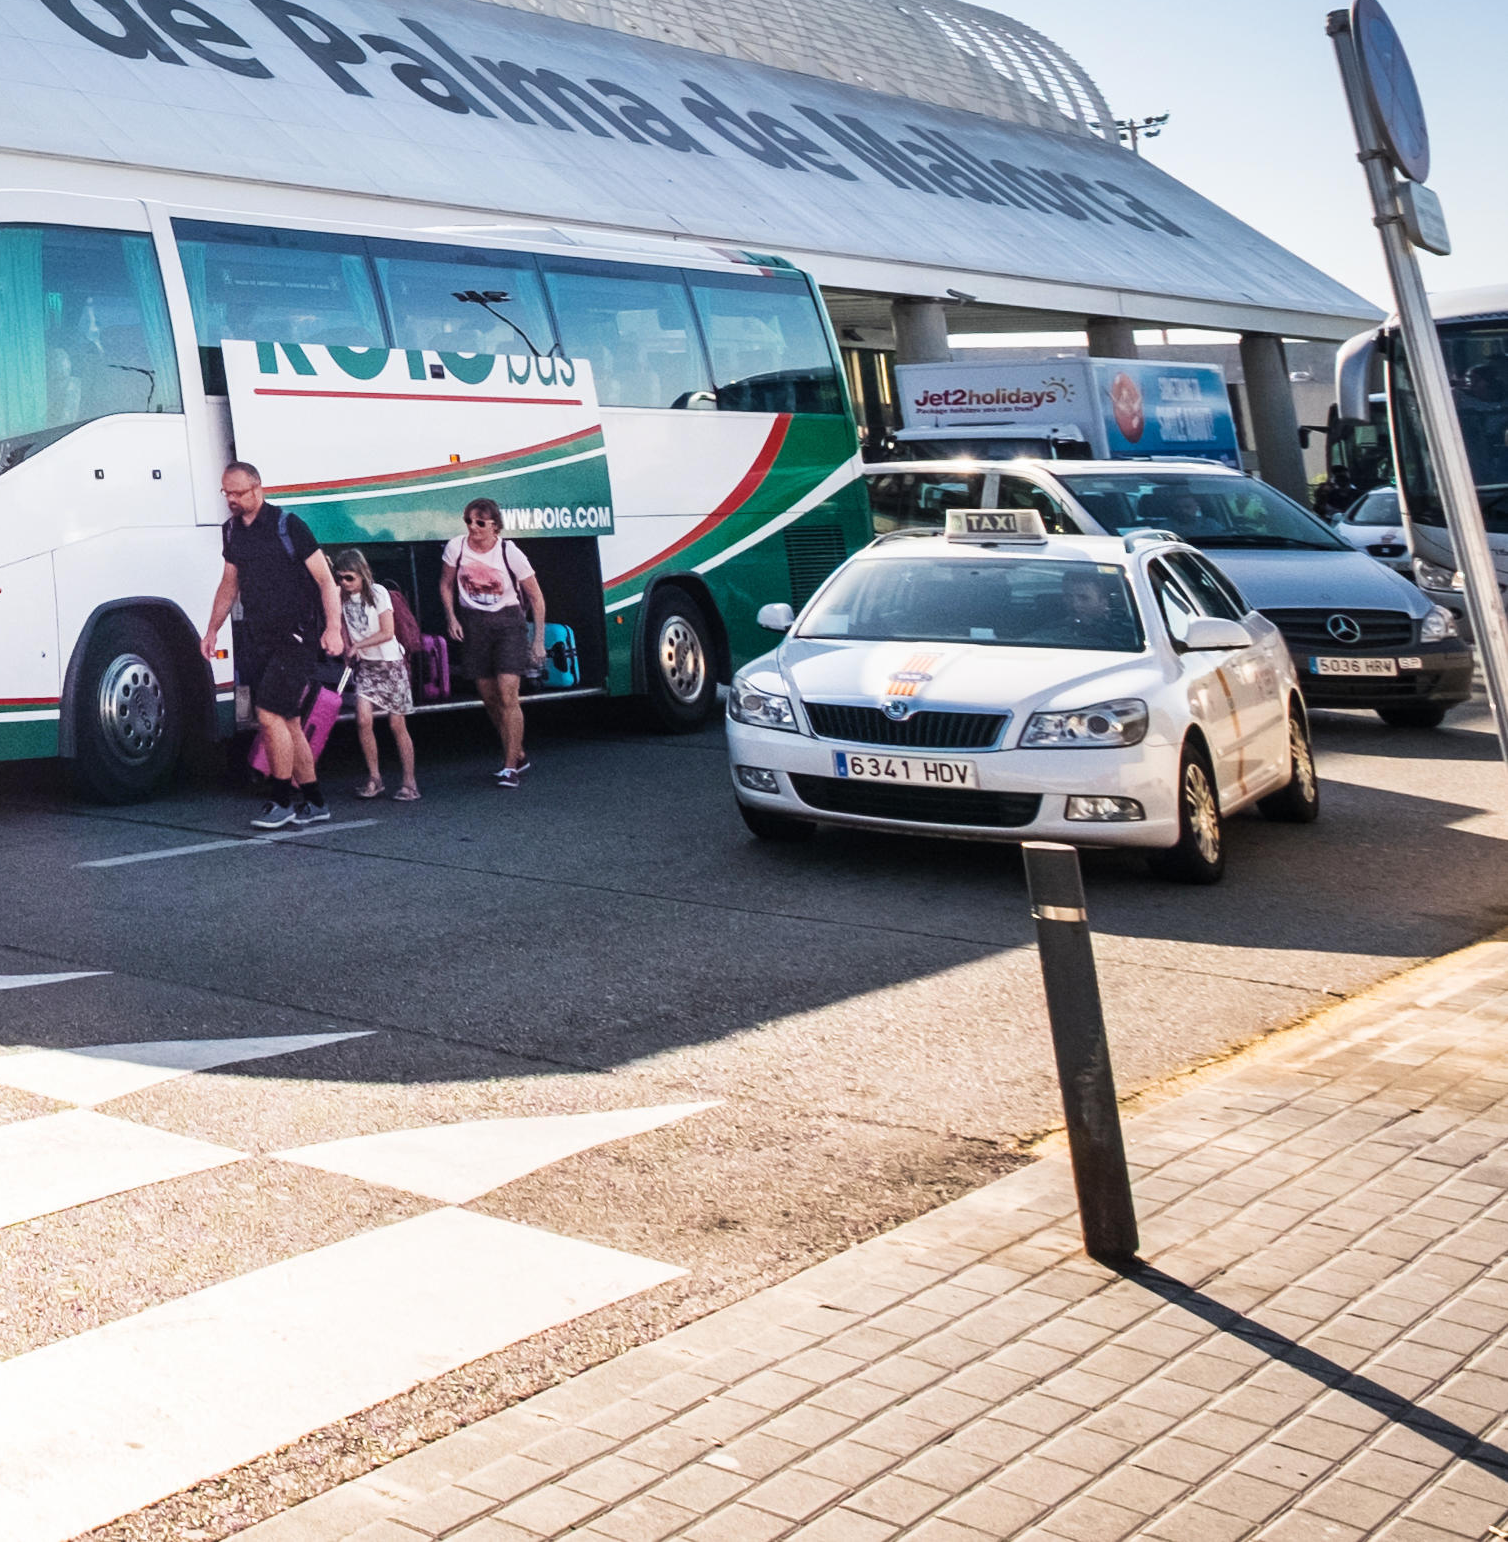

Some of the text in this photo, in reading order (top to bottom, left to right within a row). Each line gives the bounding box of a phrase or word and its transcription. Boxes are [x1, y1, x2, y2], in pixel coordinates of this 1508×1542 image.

[681, 80, 860, 182] de
[791, 104, 1194, 238] Mallorca
[914, 388, 1057, 408] Jet2holidays
[499, 506, 611, 531] WW.ROIG.COM
[968, 514, 1017, 532] TAXI
[1320, 659, 1360, 673] 5036
[850, 756, 970, 785] 6341 HDV
